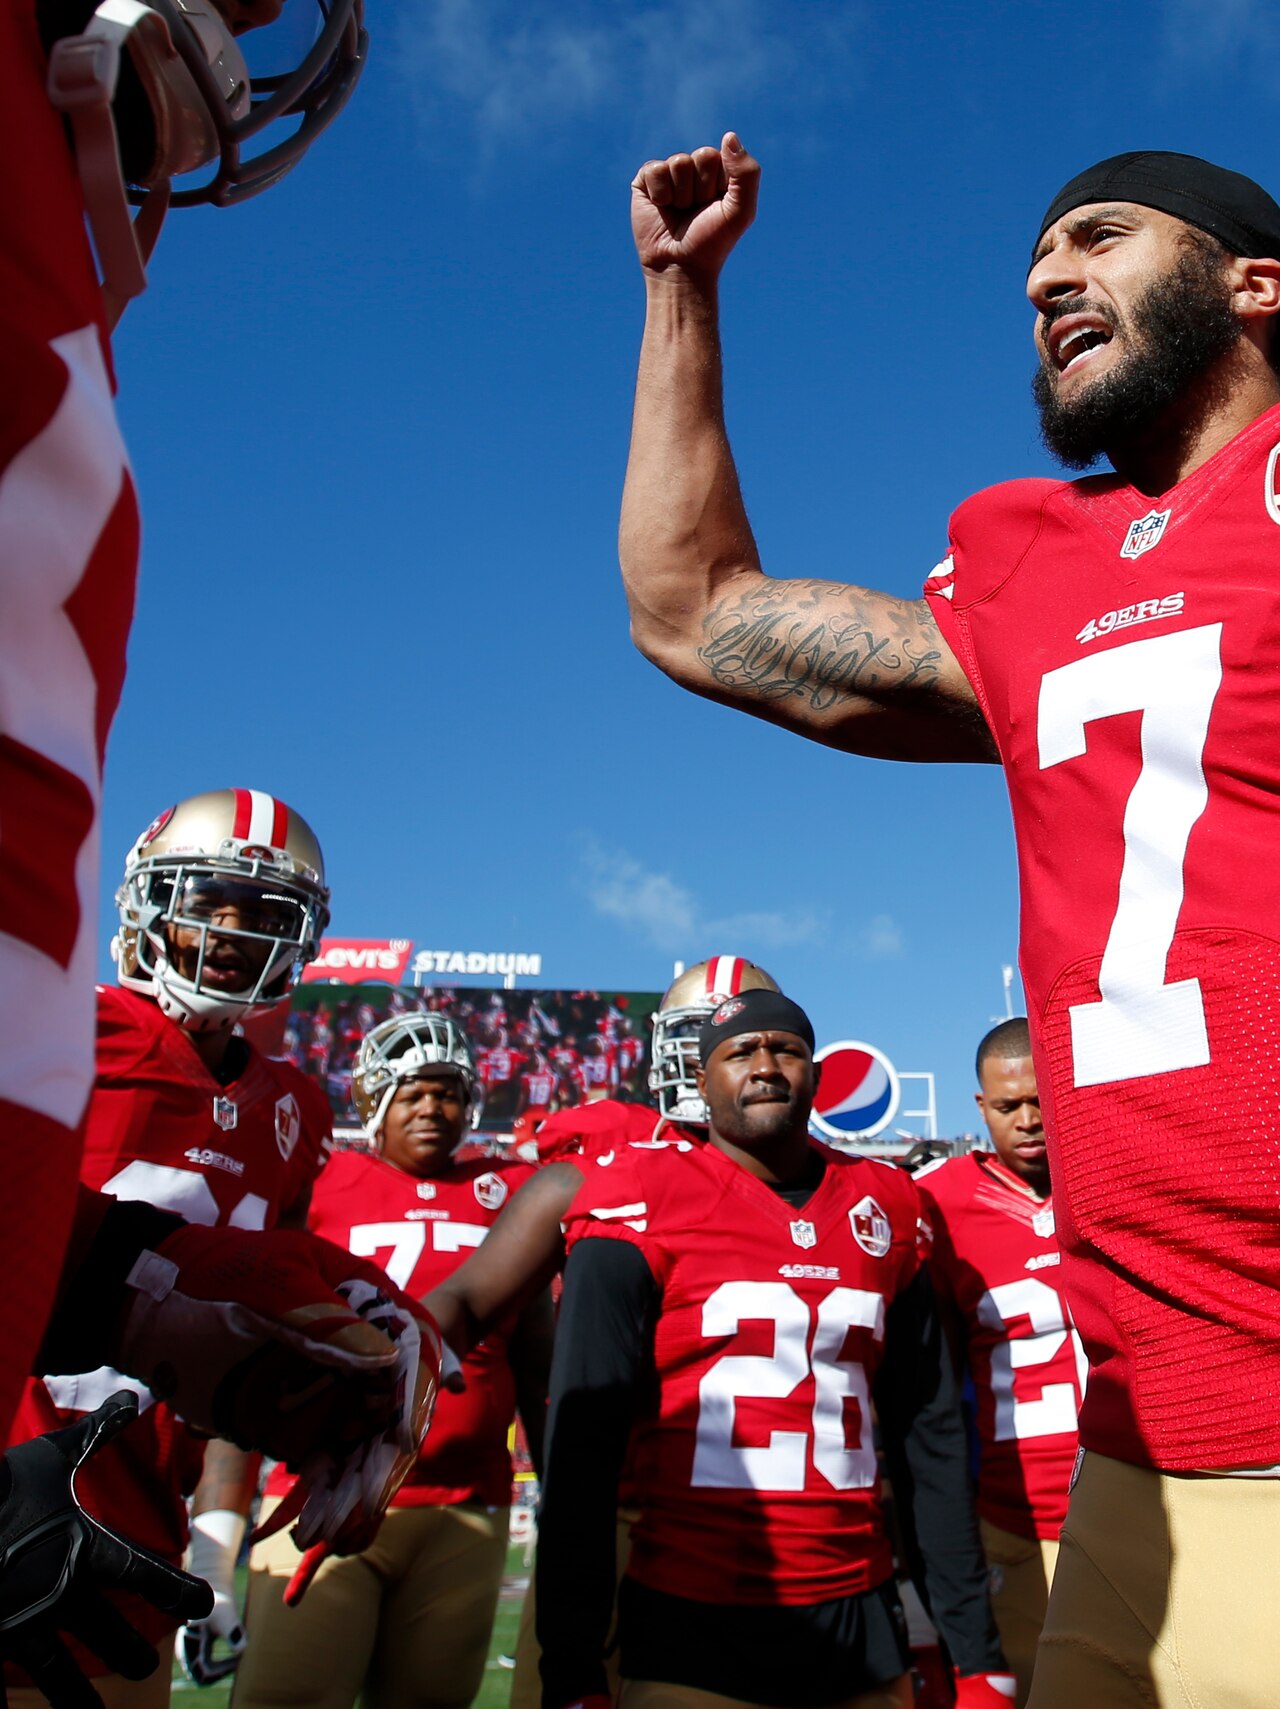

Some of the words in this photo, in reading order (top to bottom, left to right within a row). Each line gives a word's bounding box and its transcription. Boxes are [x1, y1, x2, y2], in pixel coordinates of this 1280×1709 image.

[1127, 529, 1157, 552] NFL
[1075, 591, 1185, 644] 49ERS
[1036, 621, 1223, 1089] 7
[411, 950, 542, 976] STADIUM
[183, 1147, 245, 1178] 49ERS
[690, 1280, 886, 1491] 26
[976, 1277, 1091, 1442] 2
